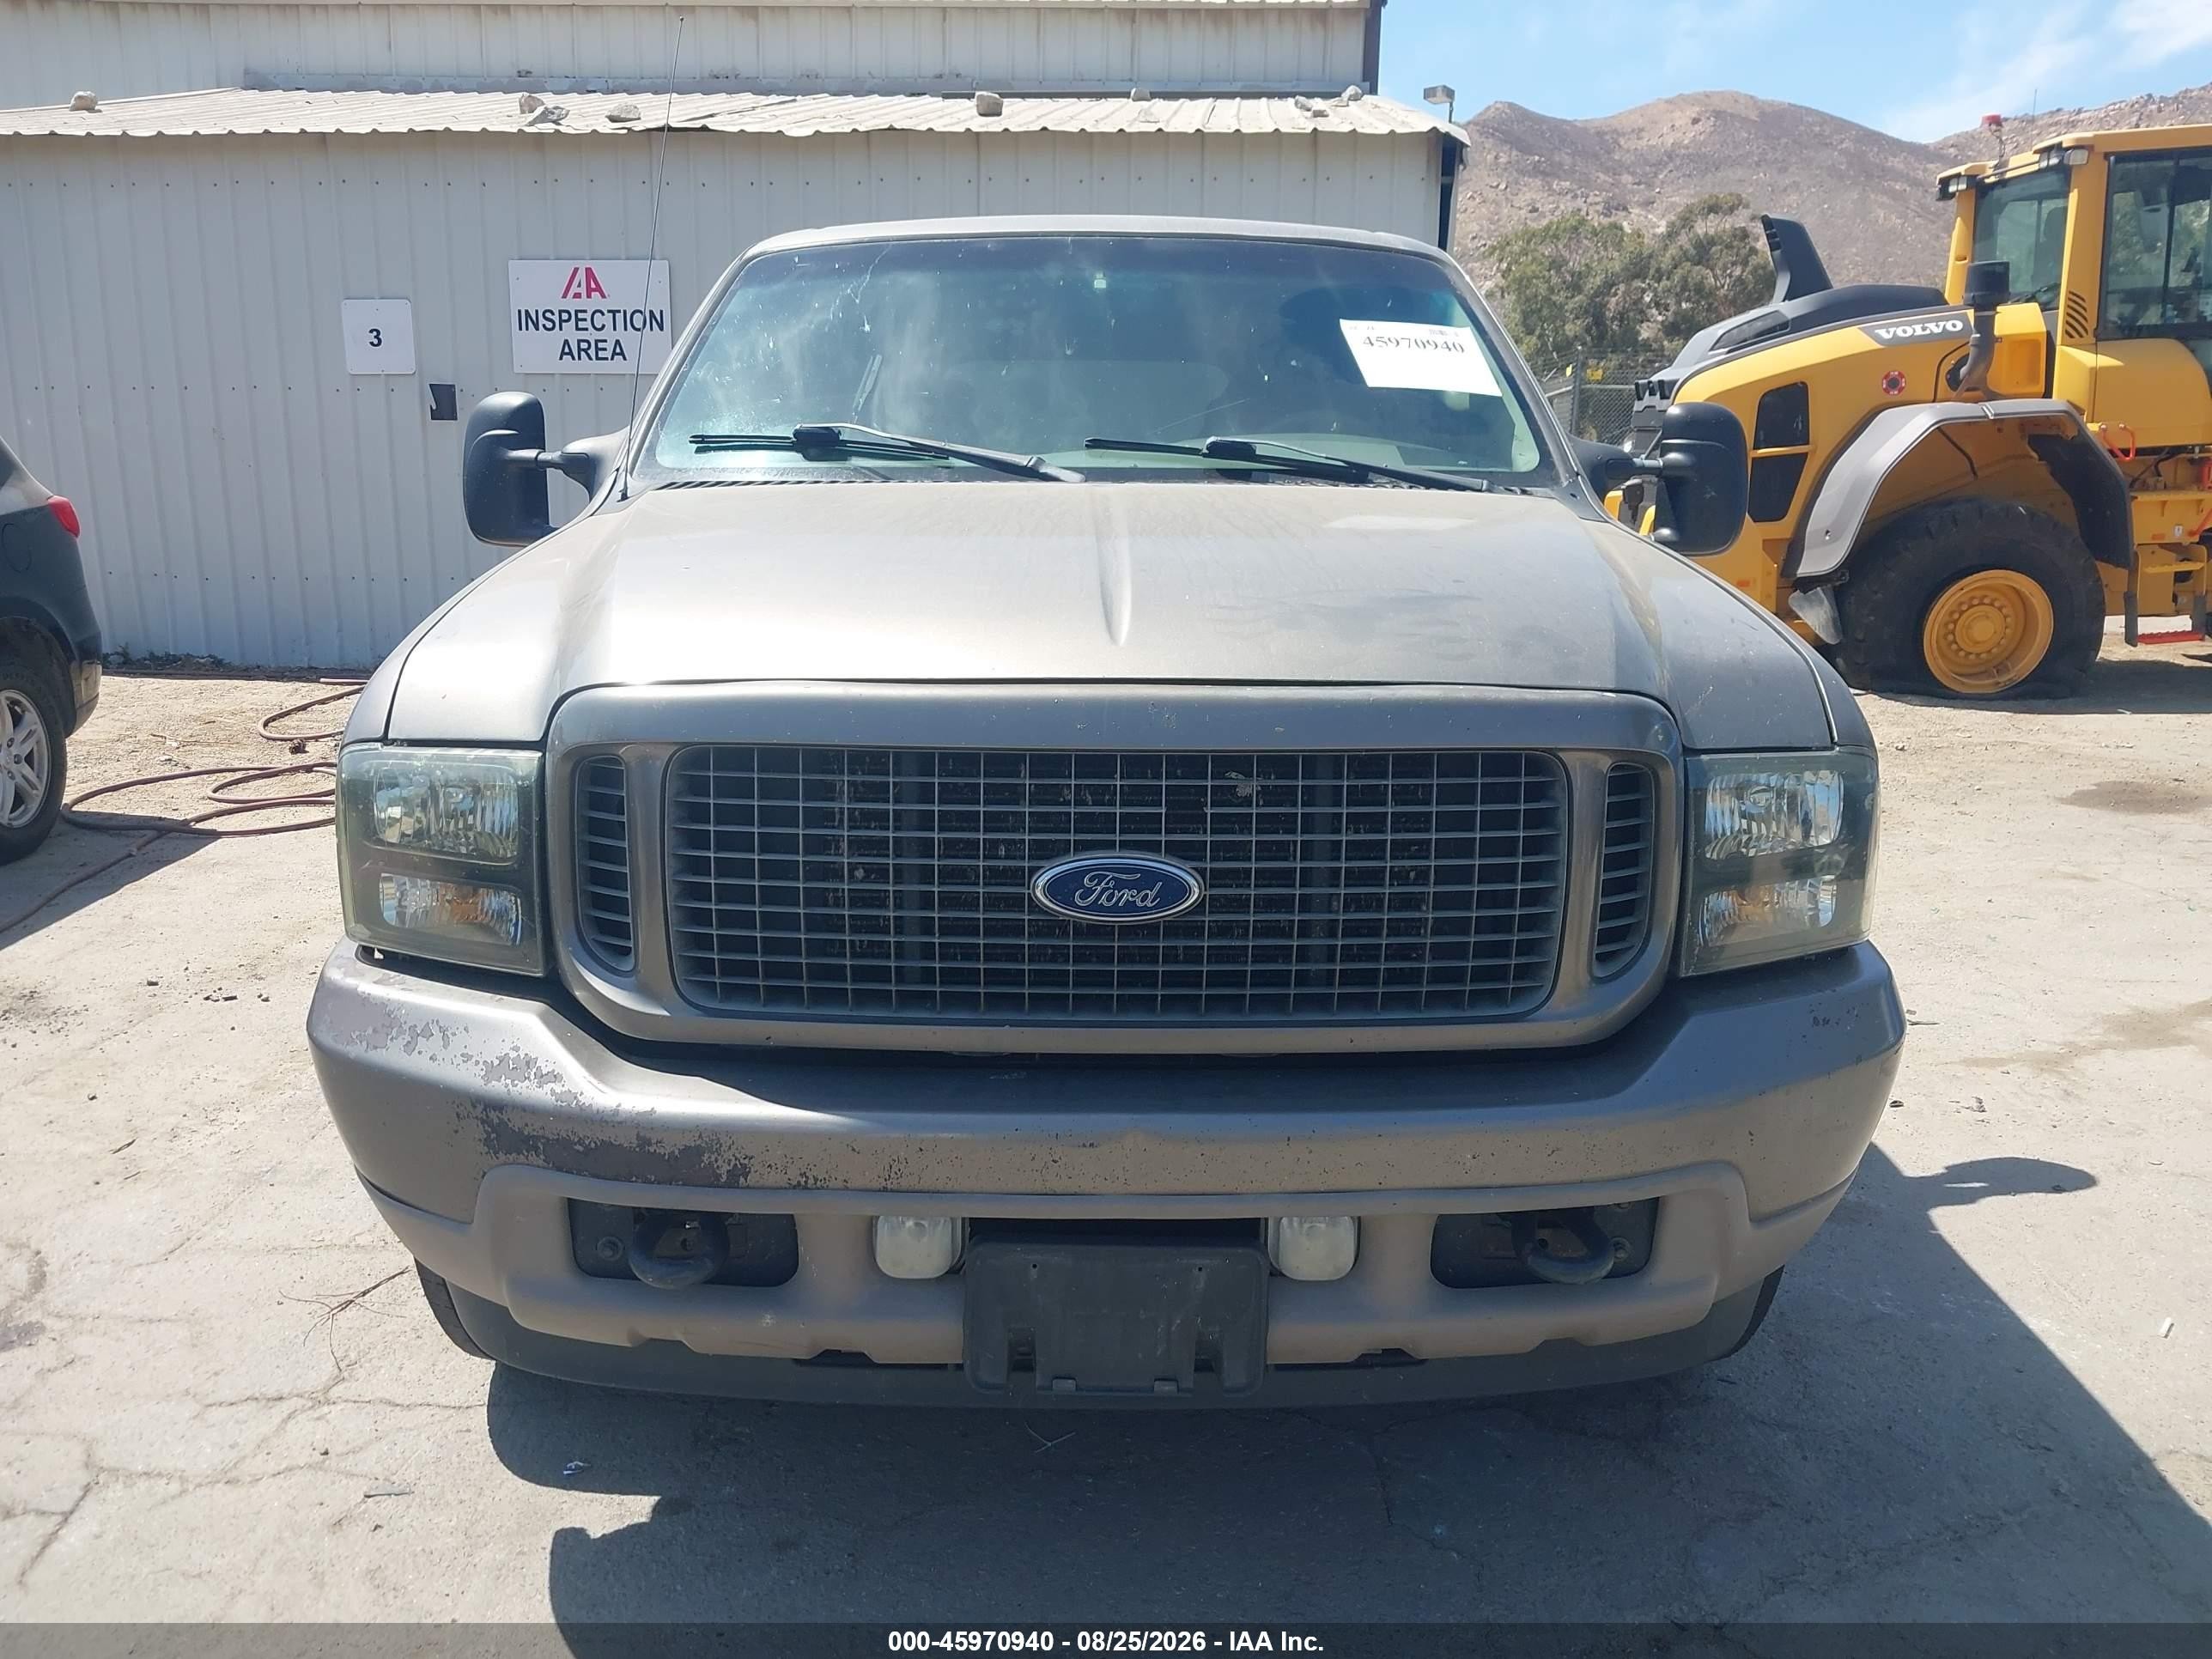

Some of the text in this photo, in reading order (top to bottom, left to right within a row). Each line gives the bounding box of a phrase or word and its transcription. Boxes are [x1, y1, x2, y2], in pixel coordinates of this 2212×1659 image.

[517, 308, 665, 333] INSPECTION
[1875, 319, 1964, 340] VOLVO
[368, 328, 383, 348] 3
[1363, 336, 1465, 353] 45970940
[558, 338, 628, 362] AREA
[1074, 871, 1163, 907] Ford
